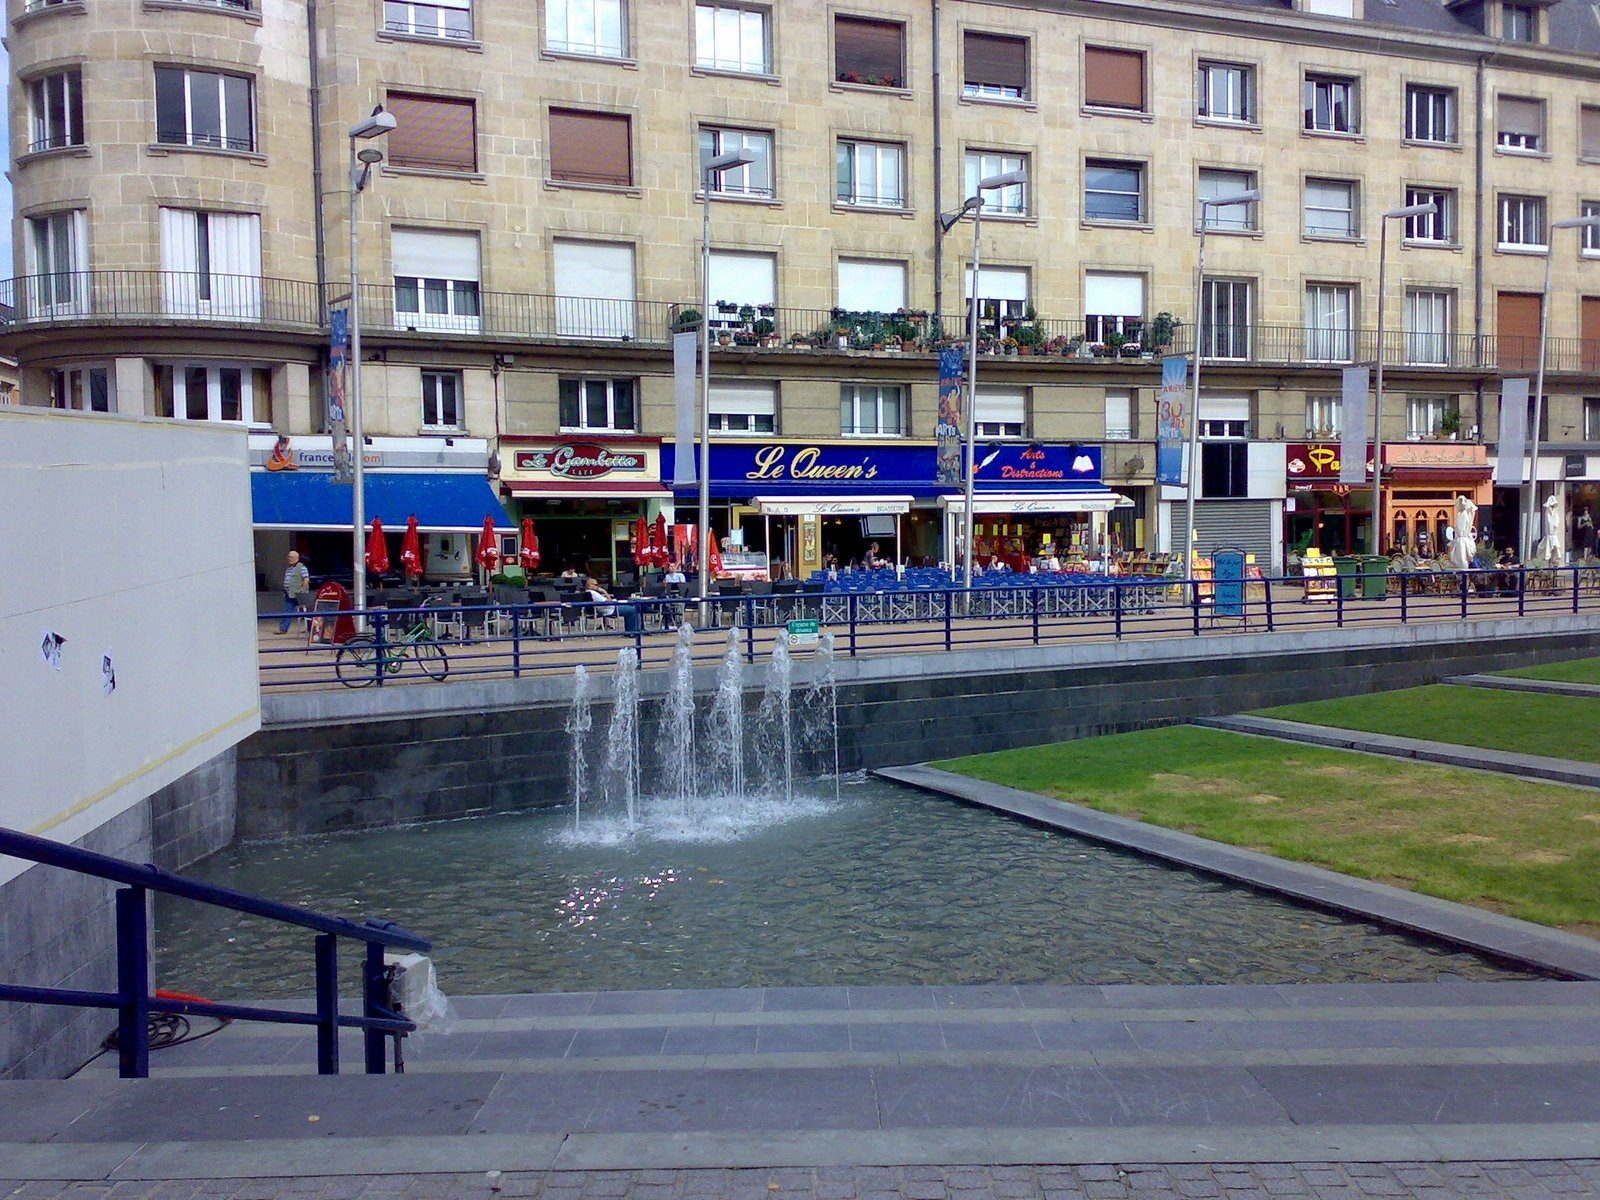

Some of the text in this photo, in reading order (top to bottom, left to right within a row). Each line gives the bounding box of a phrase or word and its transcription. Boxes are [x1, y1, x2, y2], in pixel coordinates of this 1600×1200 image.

[300, 452, 335, 462] france
[521, 446, 638, 475] Le Gambetta
[1020, 448, 1046, 460] Arts
[746, 446, 878, 479] Le Queen's
[1001, 465, 1064, 478] Distractions
